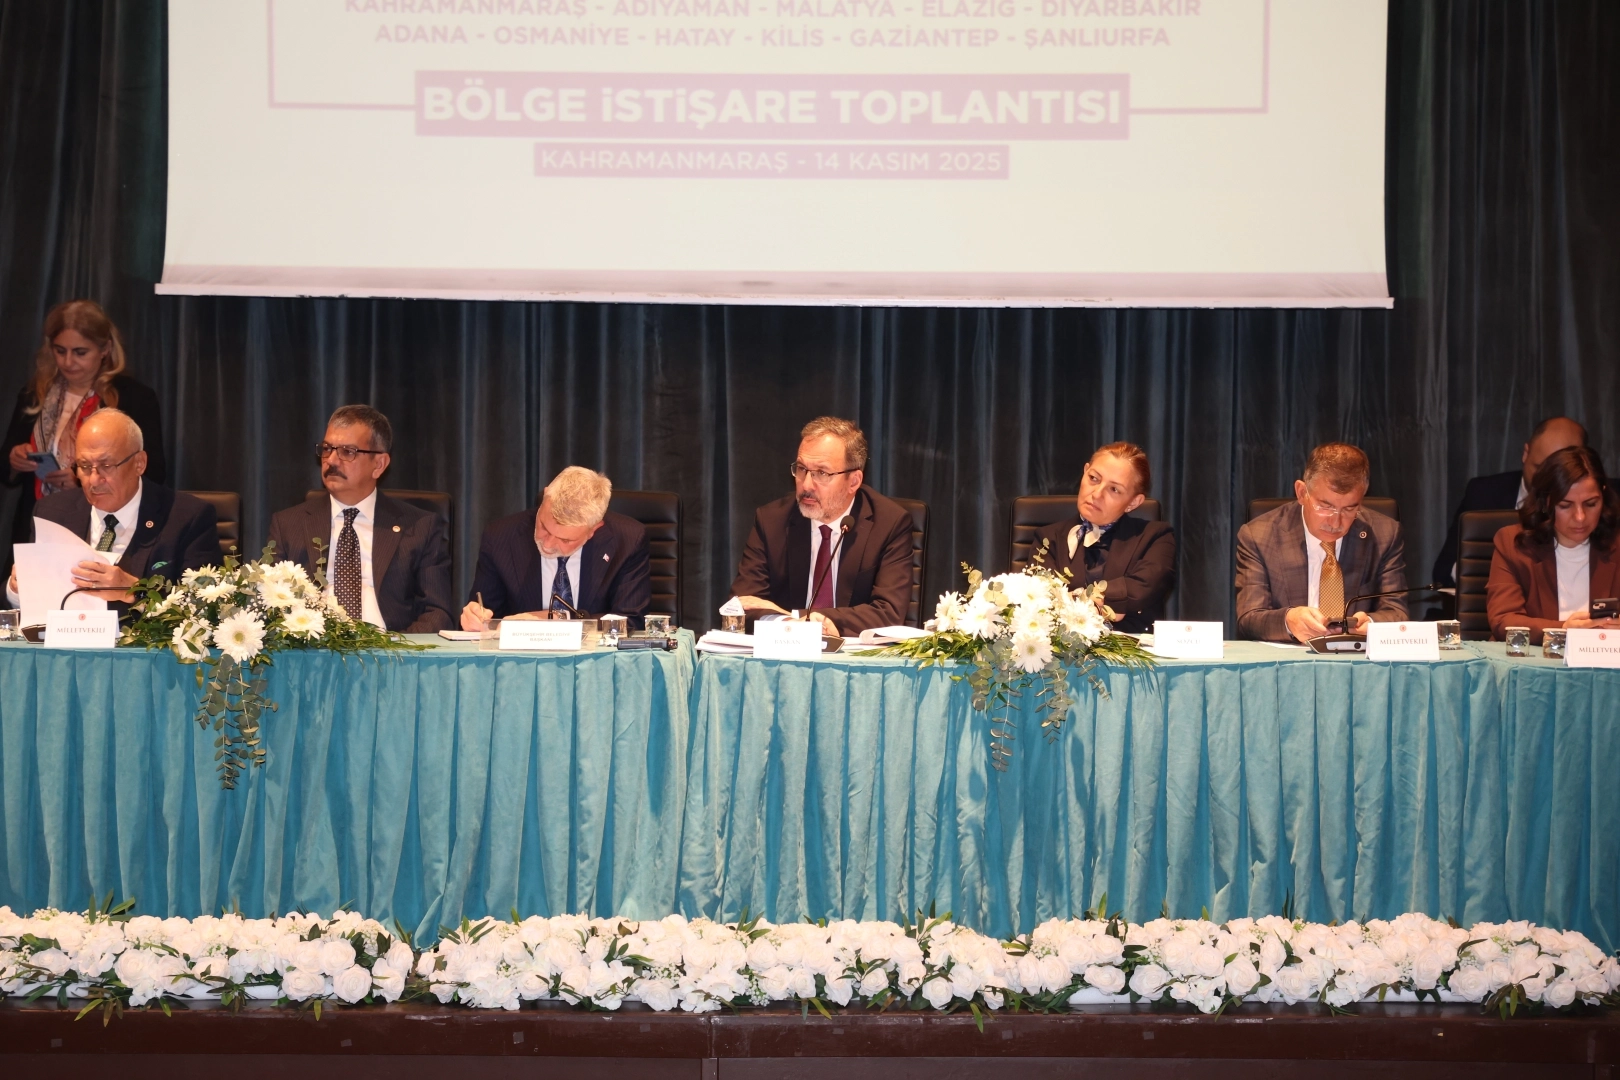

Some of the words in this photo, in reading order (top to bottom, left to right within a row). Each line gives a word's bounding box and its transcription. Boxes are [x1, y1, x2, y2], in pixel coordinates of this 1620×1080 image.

[345, 0, 587, 19] KAHRAMANMARAŞ
[613, 0, 750, 17] ADIYAMAN
[777, 0, 896, 17] MALATYA
[374, 24, 468, 44] ADANA
[494, 23, 630, 45] OSMANİYE
[655, 28, 736, 46] HATAY
[761, 24, 824, 47] KİLİS
[850, 24, 999, 47] GAZİANTEP
[1024, 27, 1171, 50] ŞANLIURFA
[423, 79, 586, 121] BÖLGE
[830, 90, 1121, 124] TOPLANTISI
[542, 150, 788, 172] KAHRAMANMARAŞ
[815, 152, 839, 171] 14
[850, 152, 930, 171] KASIM
[939, 152, 1001, 171] 2025
